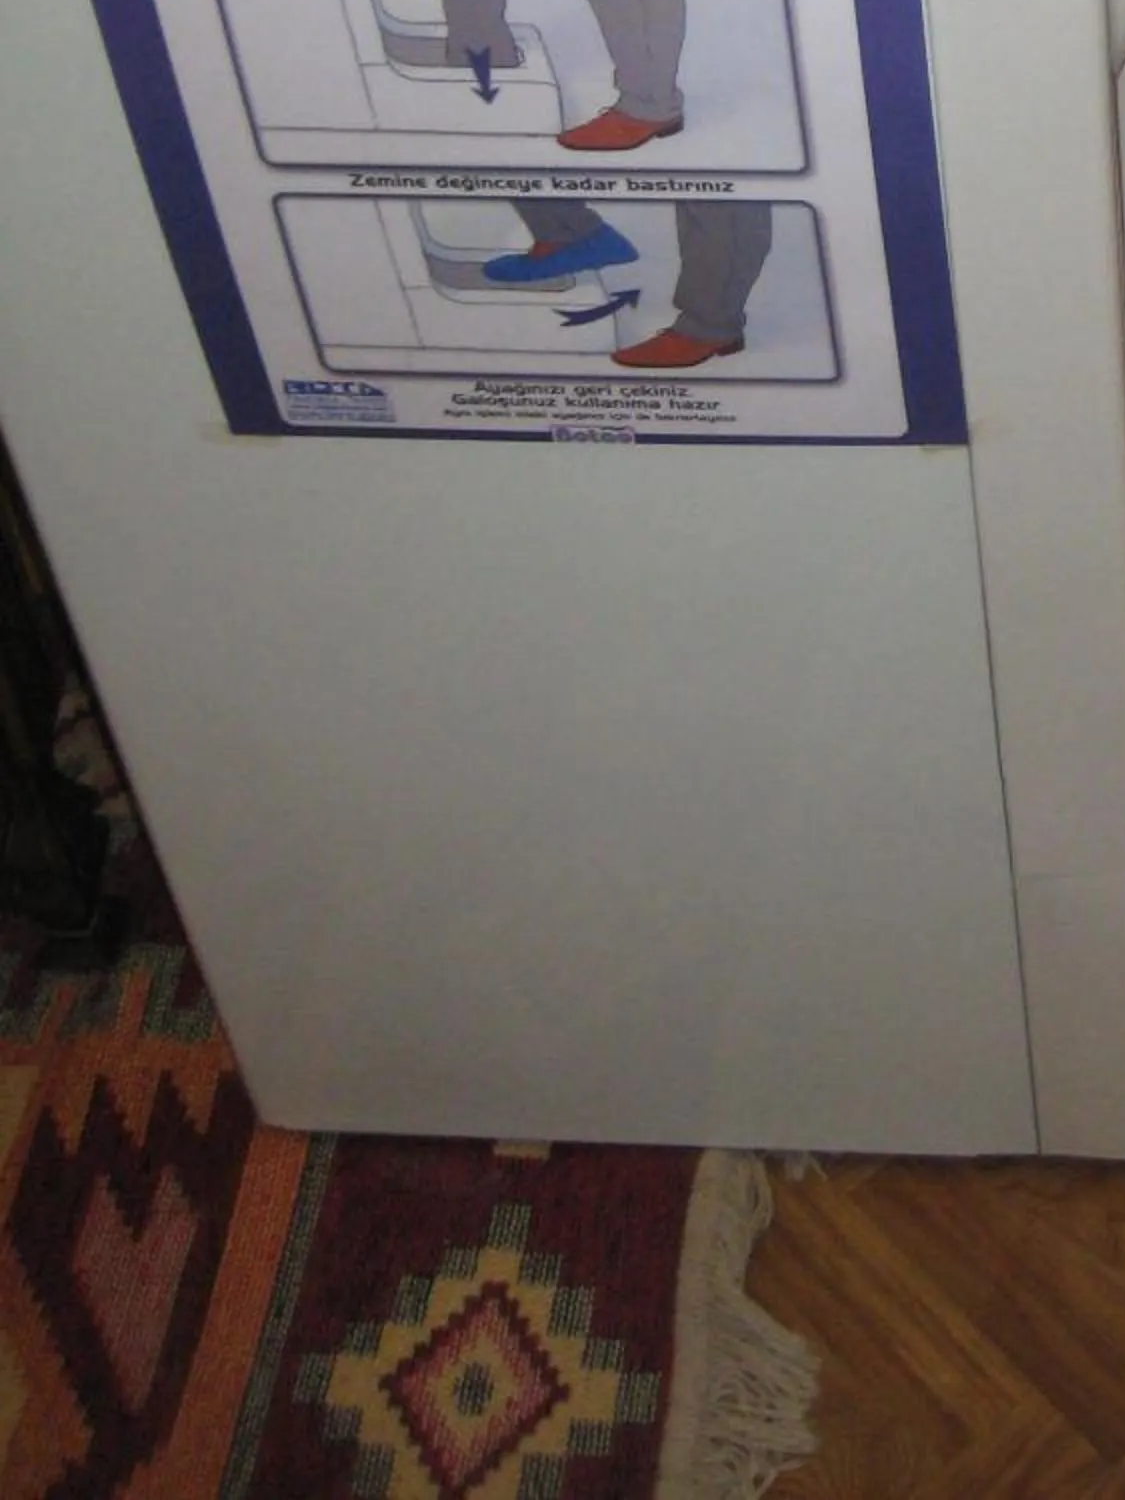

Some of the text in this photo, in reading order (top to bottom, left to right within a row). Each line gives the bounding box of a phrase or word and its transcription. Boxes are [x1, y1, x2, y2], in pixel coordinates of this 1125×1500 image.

[348, 173, 735, 193] Zemine değinceye kadar bastırınız
[573, 384, 612, 397] geri
[669, 398, 721, 411] hazır
